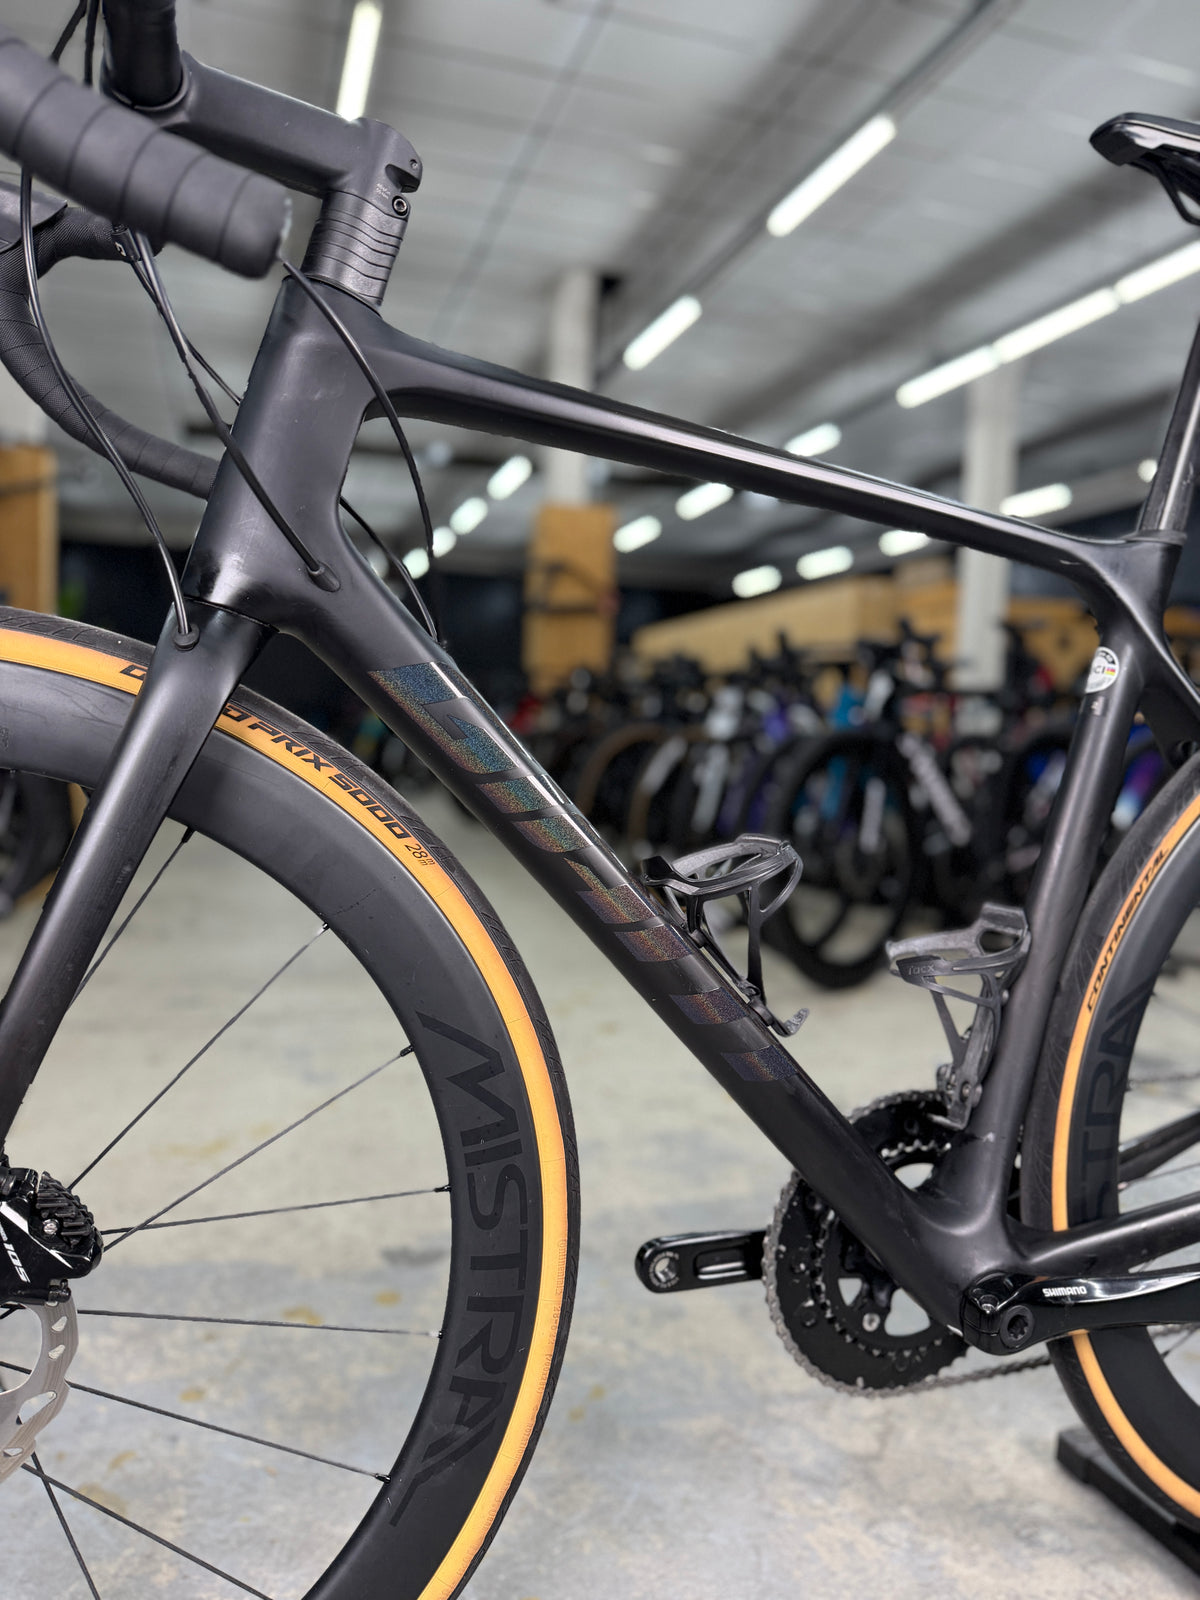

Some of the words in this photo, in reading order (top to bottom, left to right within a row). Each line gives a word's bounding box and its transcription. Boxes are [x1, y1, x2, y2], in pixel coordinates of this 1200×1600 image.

[248, 721, 334, 772] PRIX
[328, 773, 411, 839] 5000
[1086, 848, 1169, 1013] CONTINENTAL
[1042, 1285, 1087, 1298] SHIMANO
